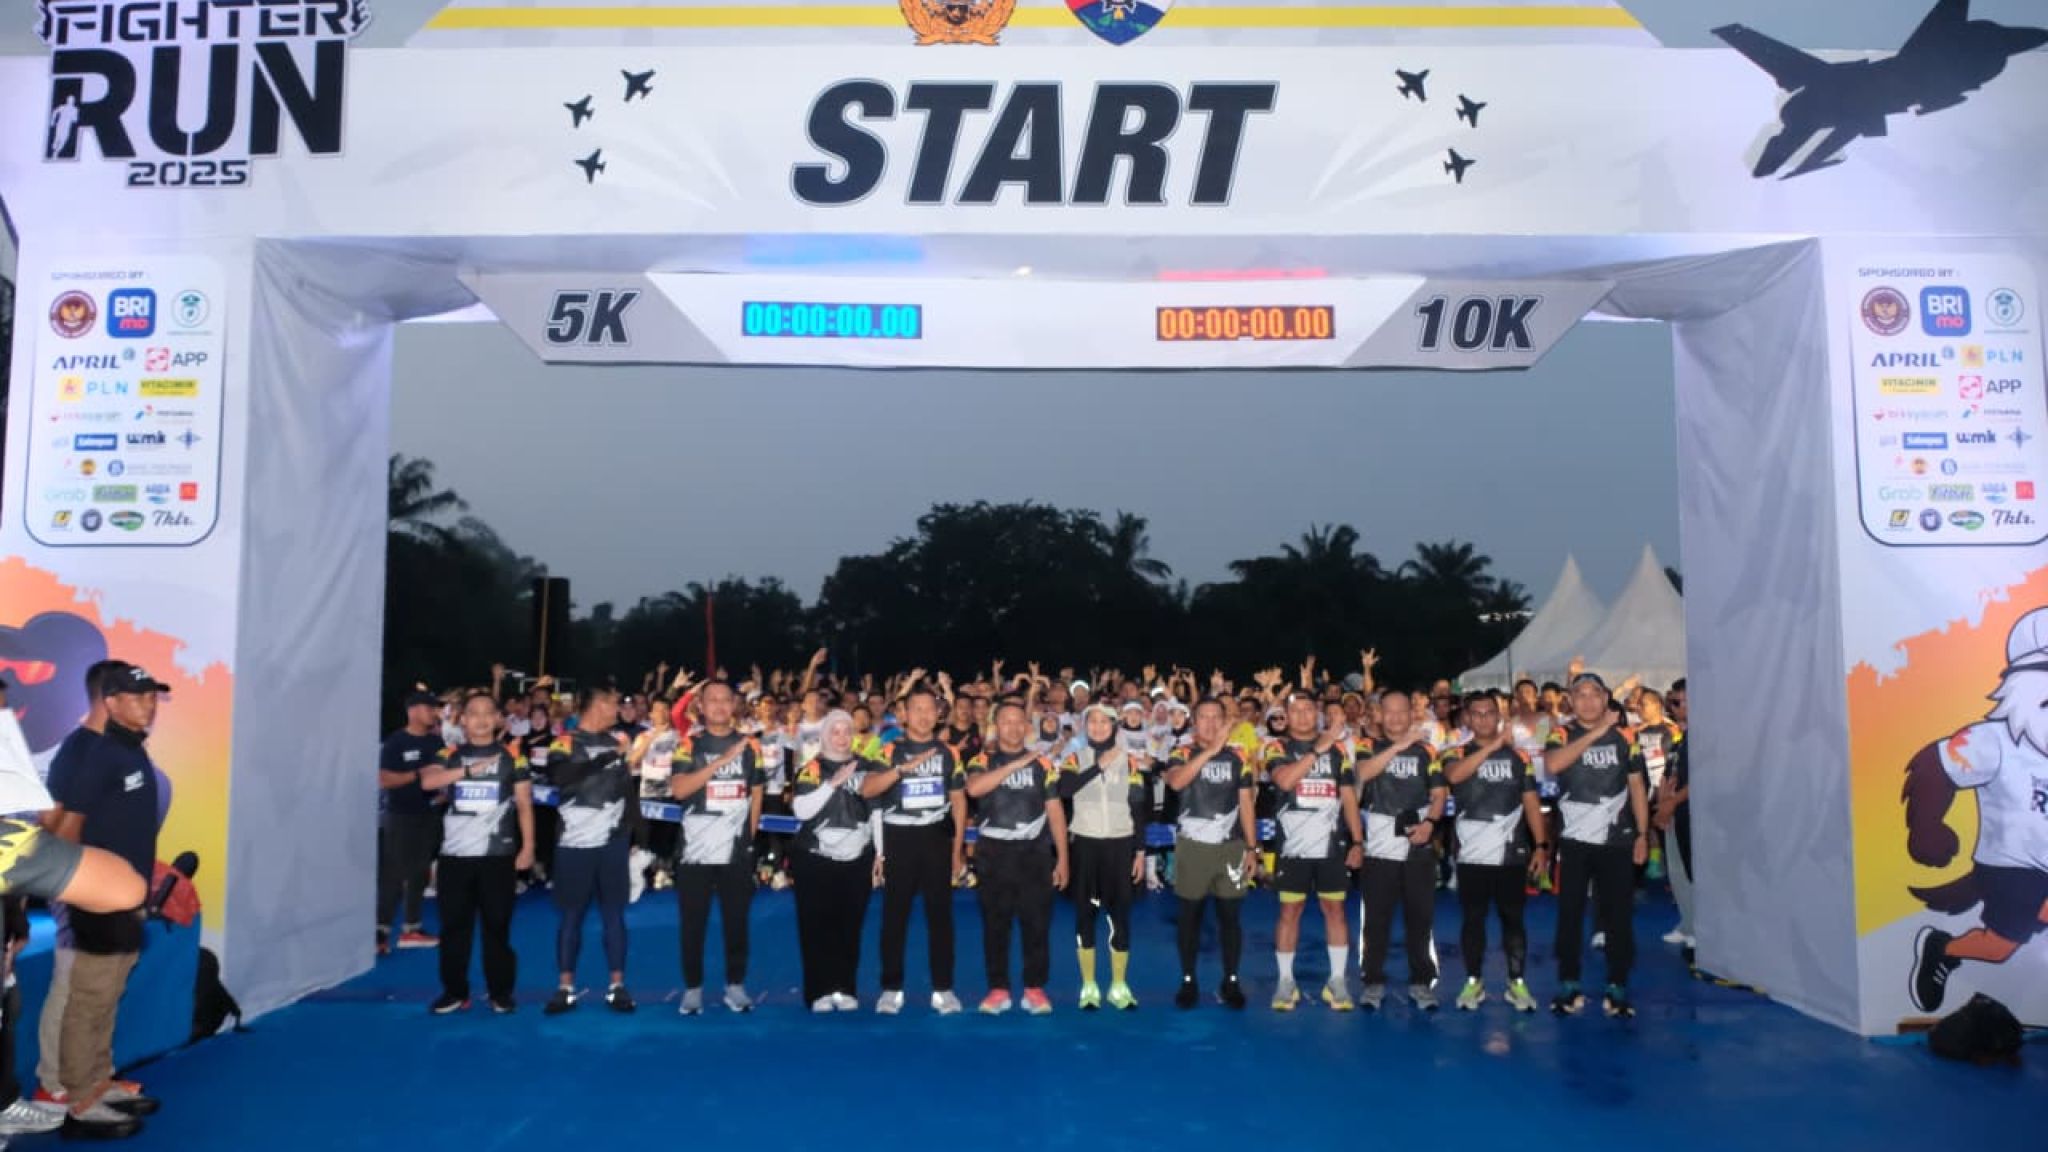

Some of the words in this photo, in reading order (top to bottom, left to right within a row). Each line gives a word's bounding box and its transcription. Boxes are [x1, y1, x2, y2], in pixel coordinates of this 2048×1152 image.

[55, 0, 348, 44] FIGHTER
[47, 40, 345, 159] RUN
[791, 78, 1280, 206] START
[127, 160, 248, 187] 2025
[114, 295, 151, 318] BRI
[1927, 294, 1964, 316] BRI
[119, 317, 149, 330] mo
[546, 290, 638, 344] 5K
[744, 303, 919, 338] 00:00:00.00
[1158, 308, 1332, 340] 00:00:00.00
[1417, 295, 1538, 351] 10K
[1936, 316, 1965, 329] mo
[51, 354, 121, 370] APRIL
[171, 352, 208, 367] APP
[1870, 353, 1942, 368] APRIL
[1986, 350, 2023, 363] PLN
[86, 380, 129, 395] PLN
[1985, 378, 2022, 394] APP
